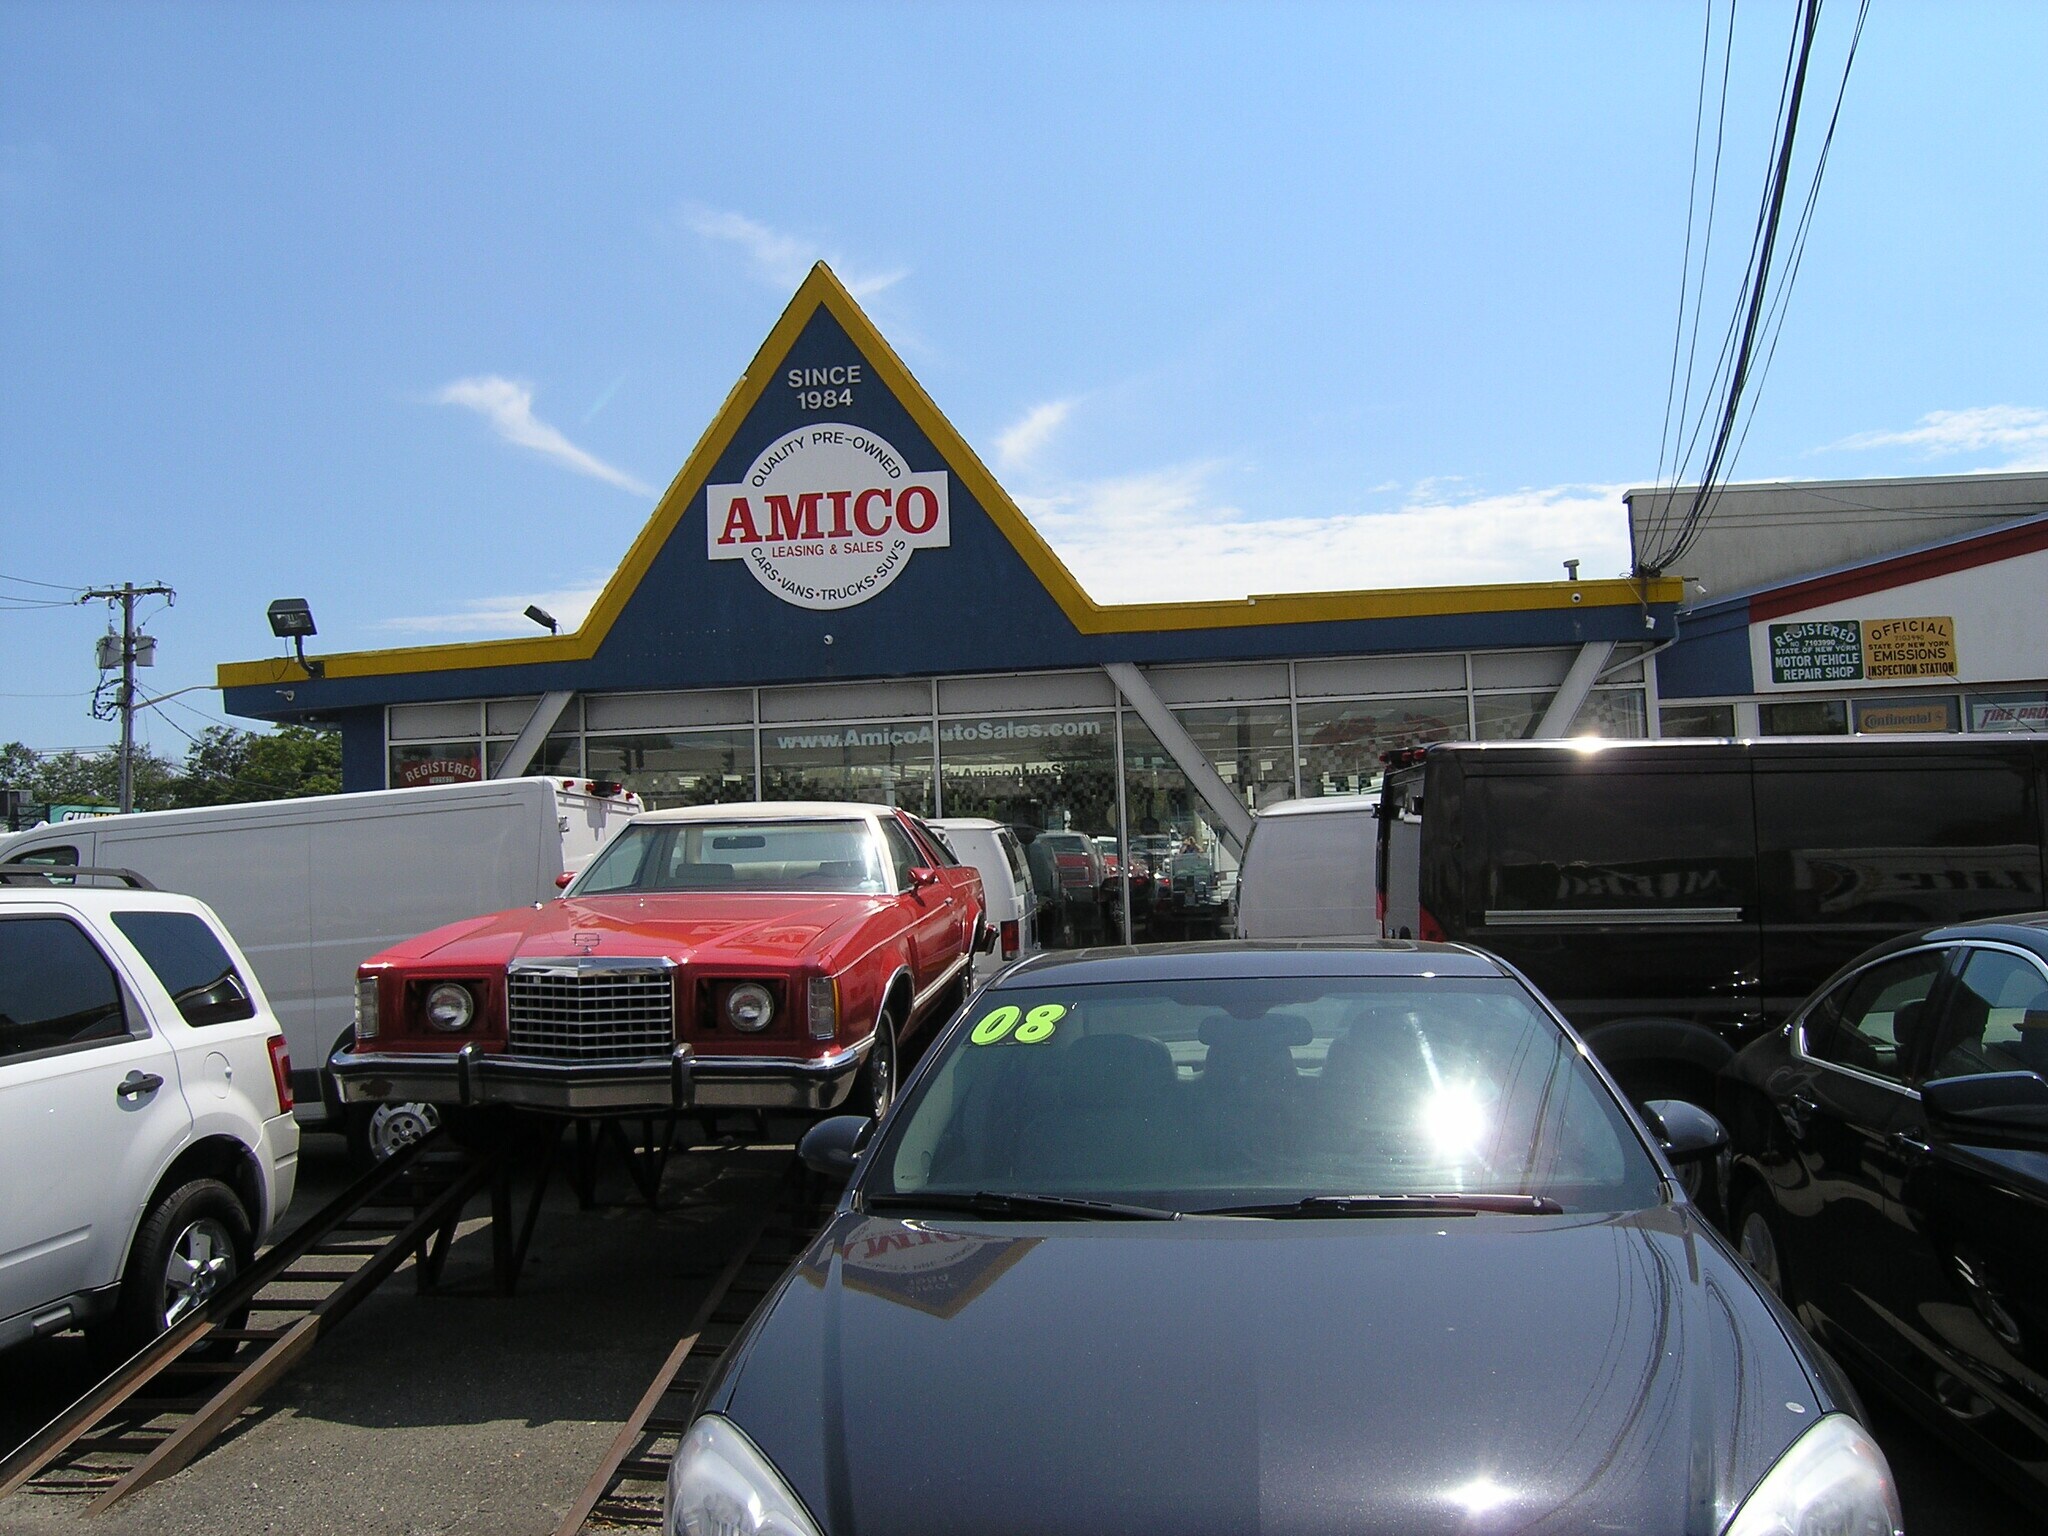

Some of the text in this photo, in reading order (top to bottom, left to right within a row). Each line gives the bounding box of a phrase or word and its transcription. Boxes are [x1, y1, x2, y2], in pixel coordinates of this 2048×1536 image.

[788, 365, 862, 388] SINCE
[797, 389, 853, 410] 1984
[752, 431, 902, 487] QUALITY PRE-OWNED
[717, 486, 939, 544] AMICO
[772, 541, 884, 558] LEASING & SALES
[751, 547, 779, 581] CARS
[780, 577, 815, 599] VANS
[821, 575, 875, 600] TRUCKS
[1774, 623, 1856, 647] REGISTERED
[1871, 620, 1948, 641] OFFICIAL
[1775, 647, 1801, 655] STATE
[1814, 645, 1833, 653] NEW
[1835, 644, 1857, 652] YORK
[1868, 643, 1892, 651] STATE
[1928, 640, 1950, 648] YORK
[1873, 648, 1947, 662] EMISSIONS
[1775, 653, 1860, 668] MOTOR VEHICLE
[1867, 662, 1955, 677] INSPECTION STATION
[1783, 666, 1854, 681] REPAIR SHOP
[1864, 712, 1932, 729] Continental
[1981, 708, 2017, 729] TIRE
[777, 720, 1100, 750] www.AmicoAutoSales.com
[405, 761, 477, 782] REGISTERED
[971, 1004, 1067, 1046] 08
